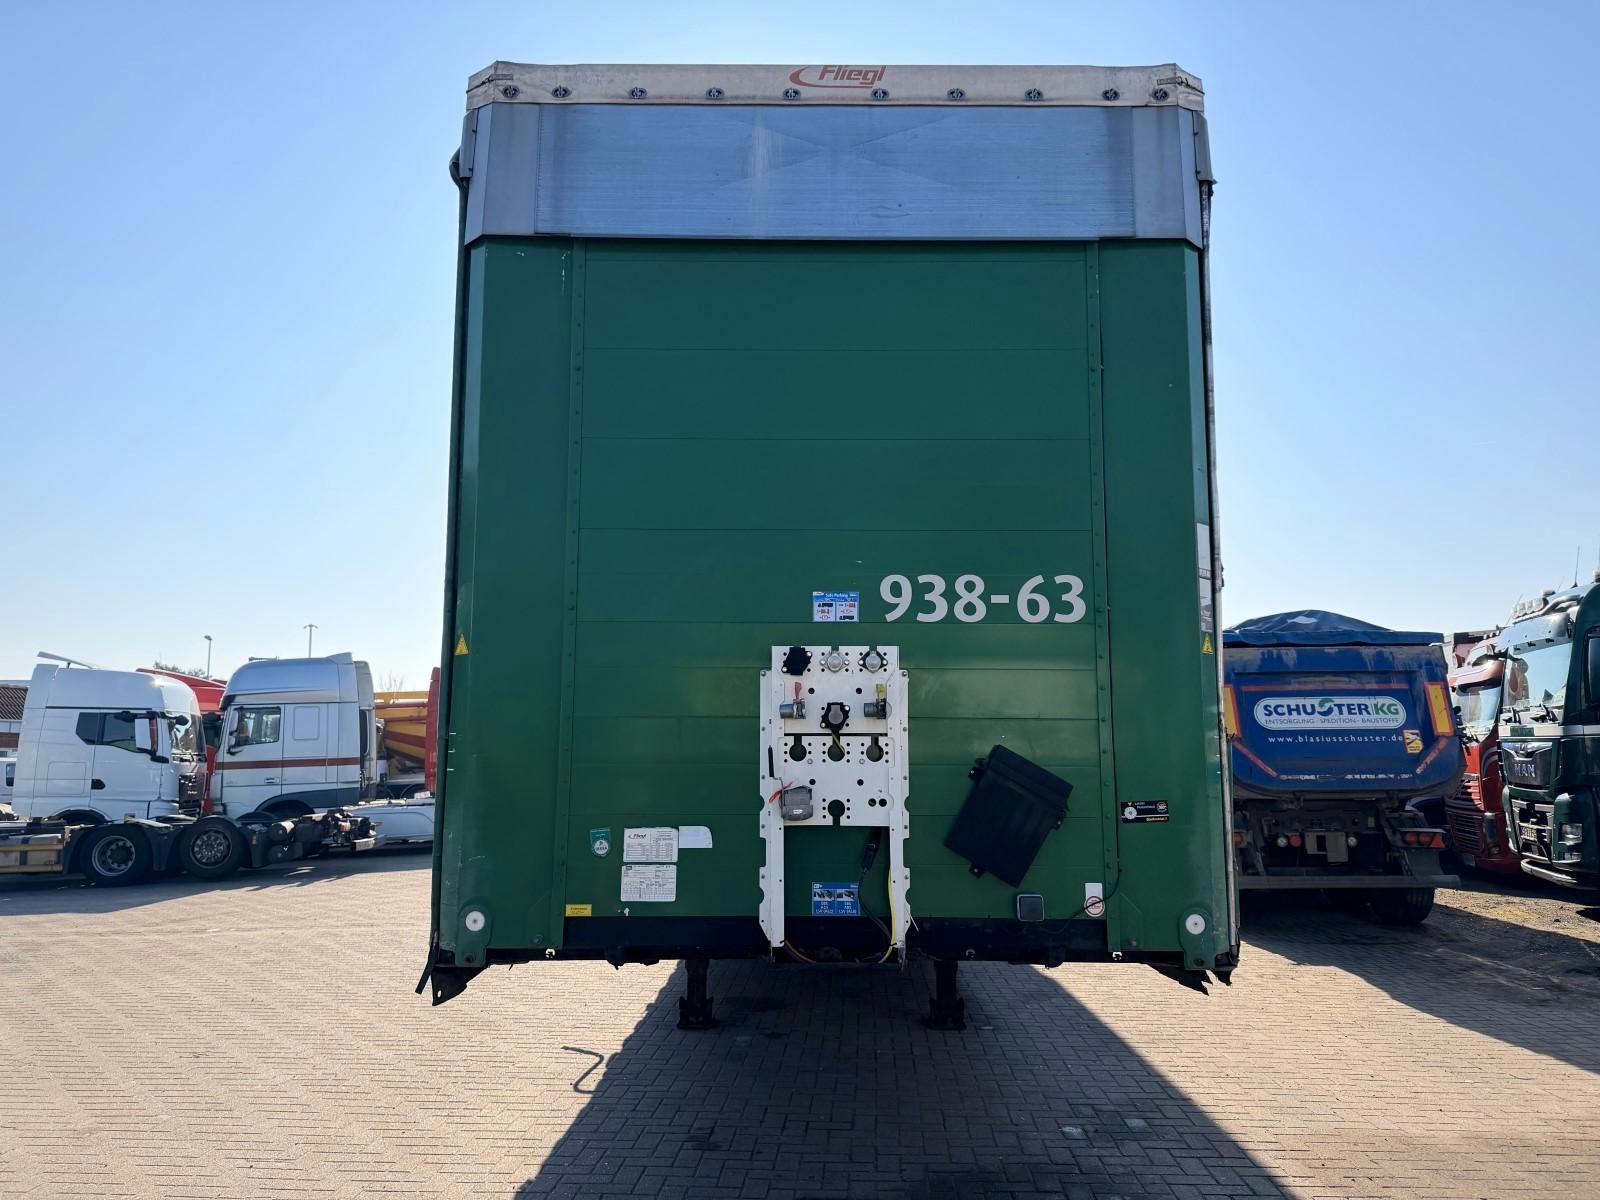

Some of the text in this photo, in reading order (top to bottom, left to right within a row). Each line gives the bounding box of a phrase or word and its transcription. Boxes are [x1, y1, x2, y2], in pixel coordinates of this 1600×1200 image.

[818, 65, 886, 85] Fliegl
[879, 574, 1087, 623] 938-63
[1263, 698, 1400, 717] SCHUSTER KG
[1268, 734, 1403, 743] www.blasiusschuster.de
[1514, 763, 1536, 778] MAN
